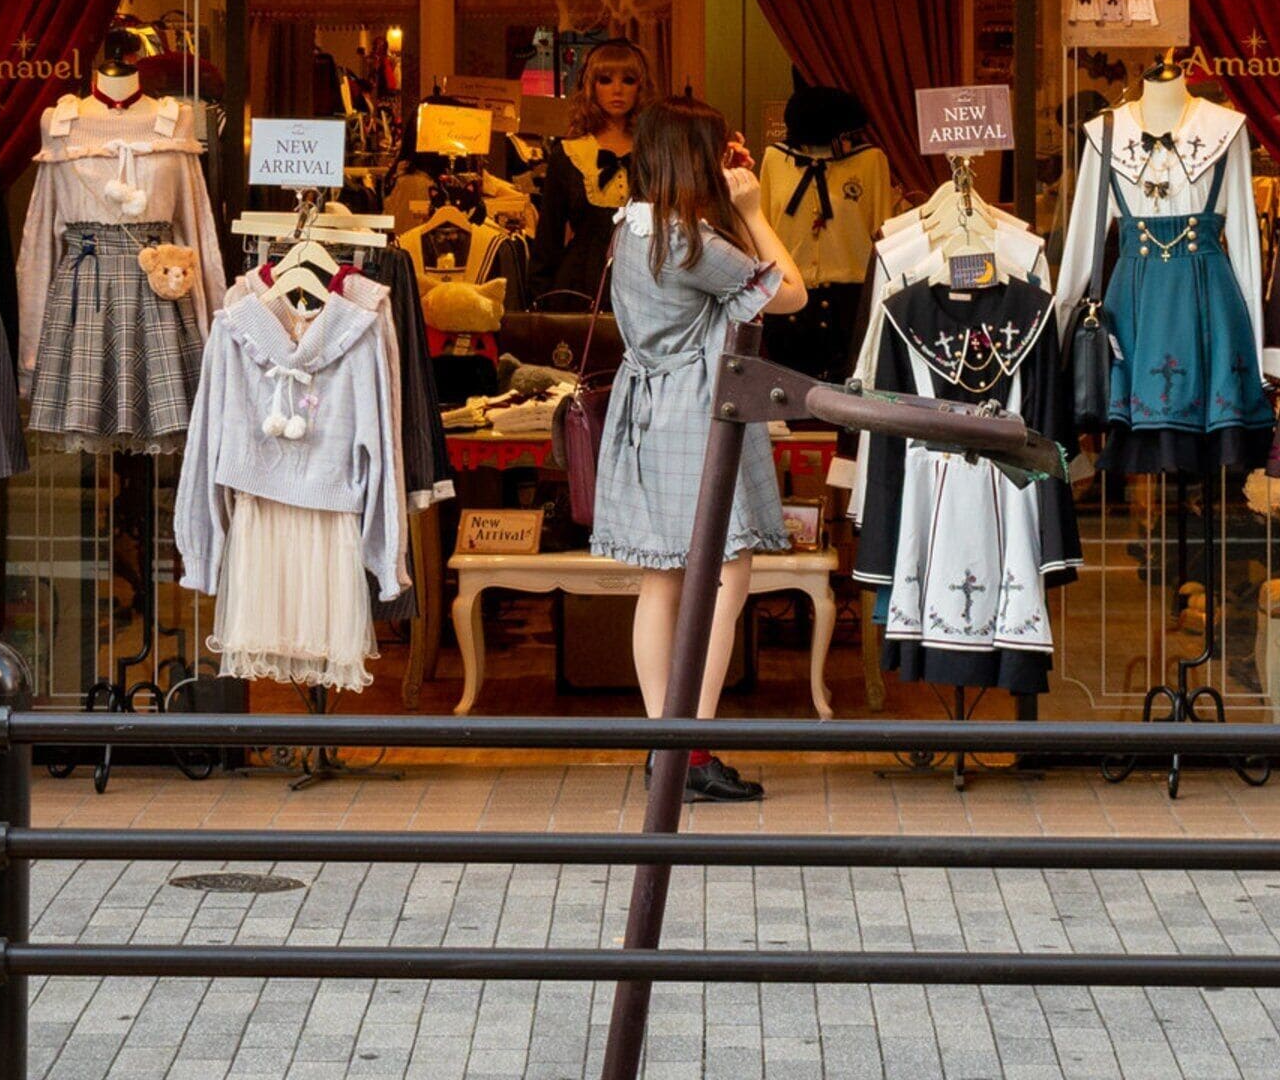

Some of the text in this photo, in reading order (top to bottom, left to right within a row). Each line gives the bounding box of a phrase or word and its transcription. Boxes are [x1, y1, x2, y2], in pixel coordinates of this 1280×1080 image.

[944, 105, 987, 122] NEW
[929, 123, 1007, 143] ARRIVAL
[276, 140, 319, 154] NEW
[259, 159, 335, 176] ARRIVAL
[471, 517, 501, 528] New
